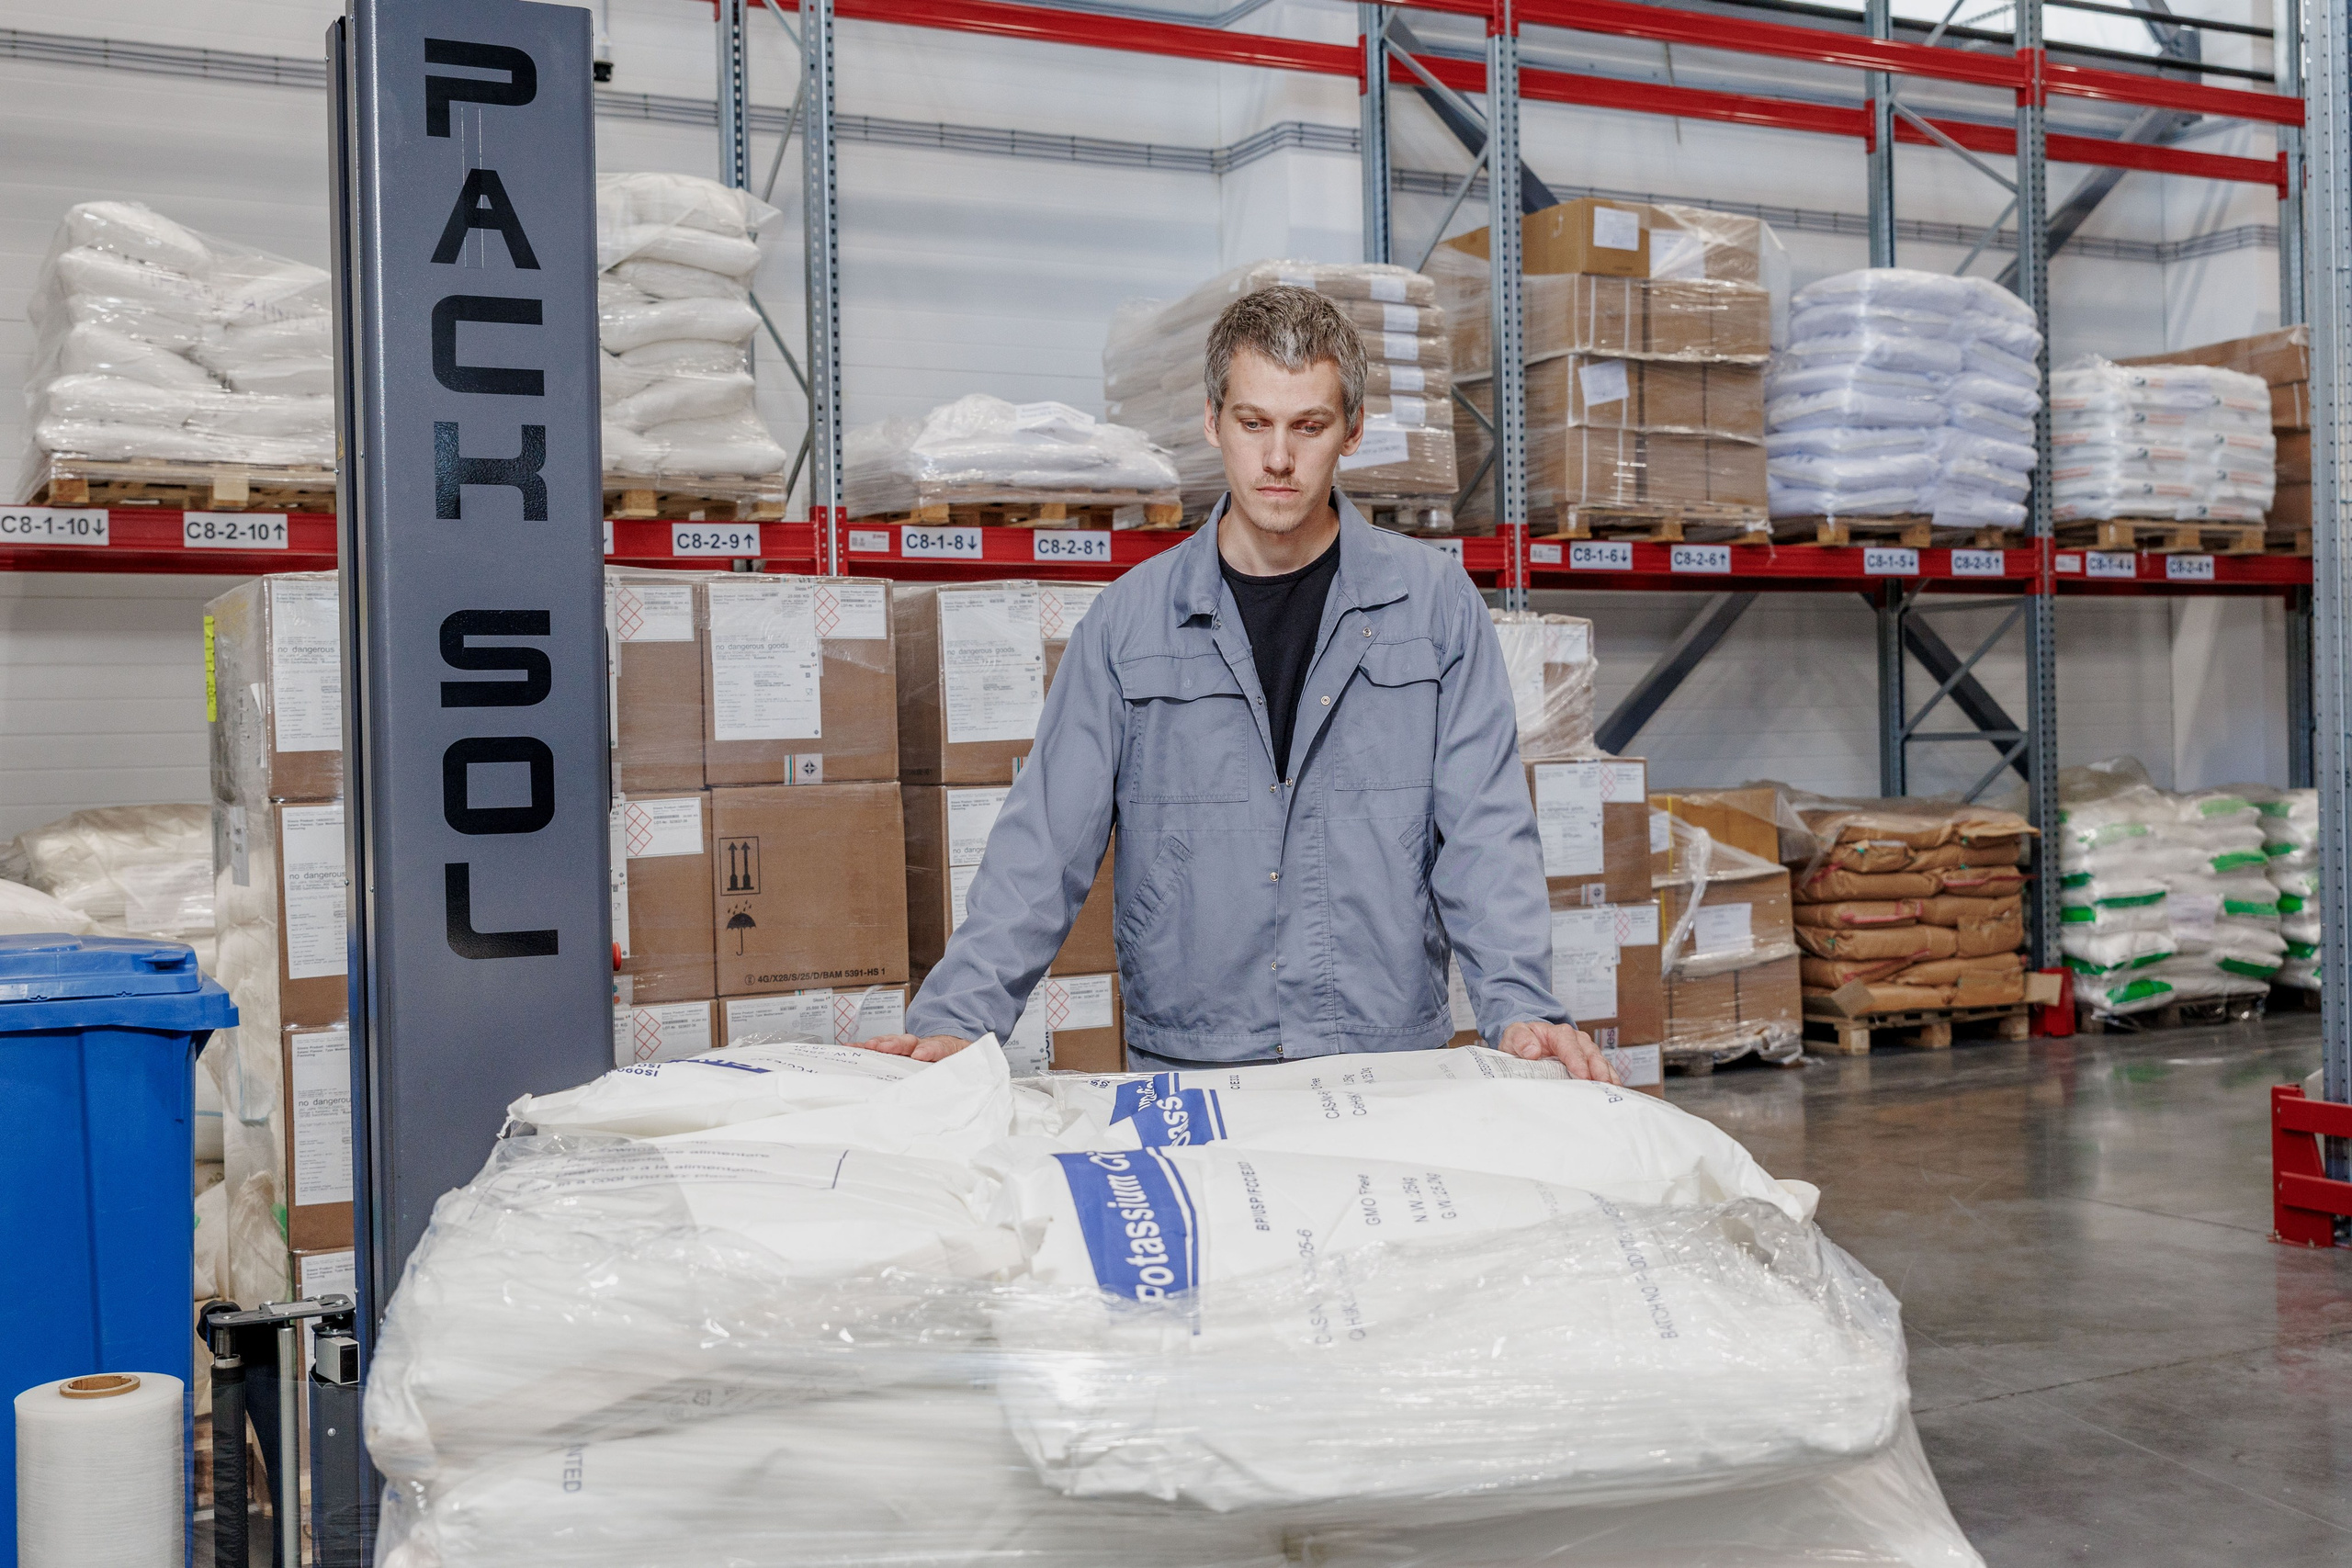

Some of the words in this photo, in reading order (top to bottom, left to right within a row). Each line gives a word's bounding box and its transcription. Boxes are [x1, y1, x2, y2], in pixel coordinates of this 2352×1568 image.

[424, 37, 548, 522] PACK
[0, 515, 89, 536] C8-1-10
[186, 522, 269, 541] C8-2-10
[676, 533, 740, 549] C8-2-9
[906, 534, 964, 550] C8-1-8
[1037, 539, 1092, 555] C8-2-8
[1573, 547, 1617, 562] C8-1-6
[1673, 551, 1716, 566] C8-2-6
[1866, 554, 1906, 568] C8-1-5
[291, 645, 335, 655] dangerous
[728, 643, 764, 651] dangerous
[767, 642, 789, 650] goods
[958, 648, 993, 656] dangerous
[438, 609, 560, 961] SOL
[303, 871, 346, 880] dangerous
[757, 970, 842, 984] 4G/X28/S/25/D/BAM
[844, 967, 879, 977] 5391-HS
[312, 1097, 351, 1107] dangerou
[1357, 1173, 1374, 1195] Free
[1360, 1197, 1382, 1226] GMO
[1106, 1174, 1175, 1303] Potassium
[1649, 1303, 1679, 1340] BATCH
